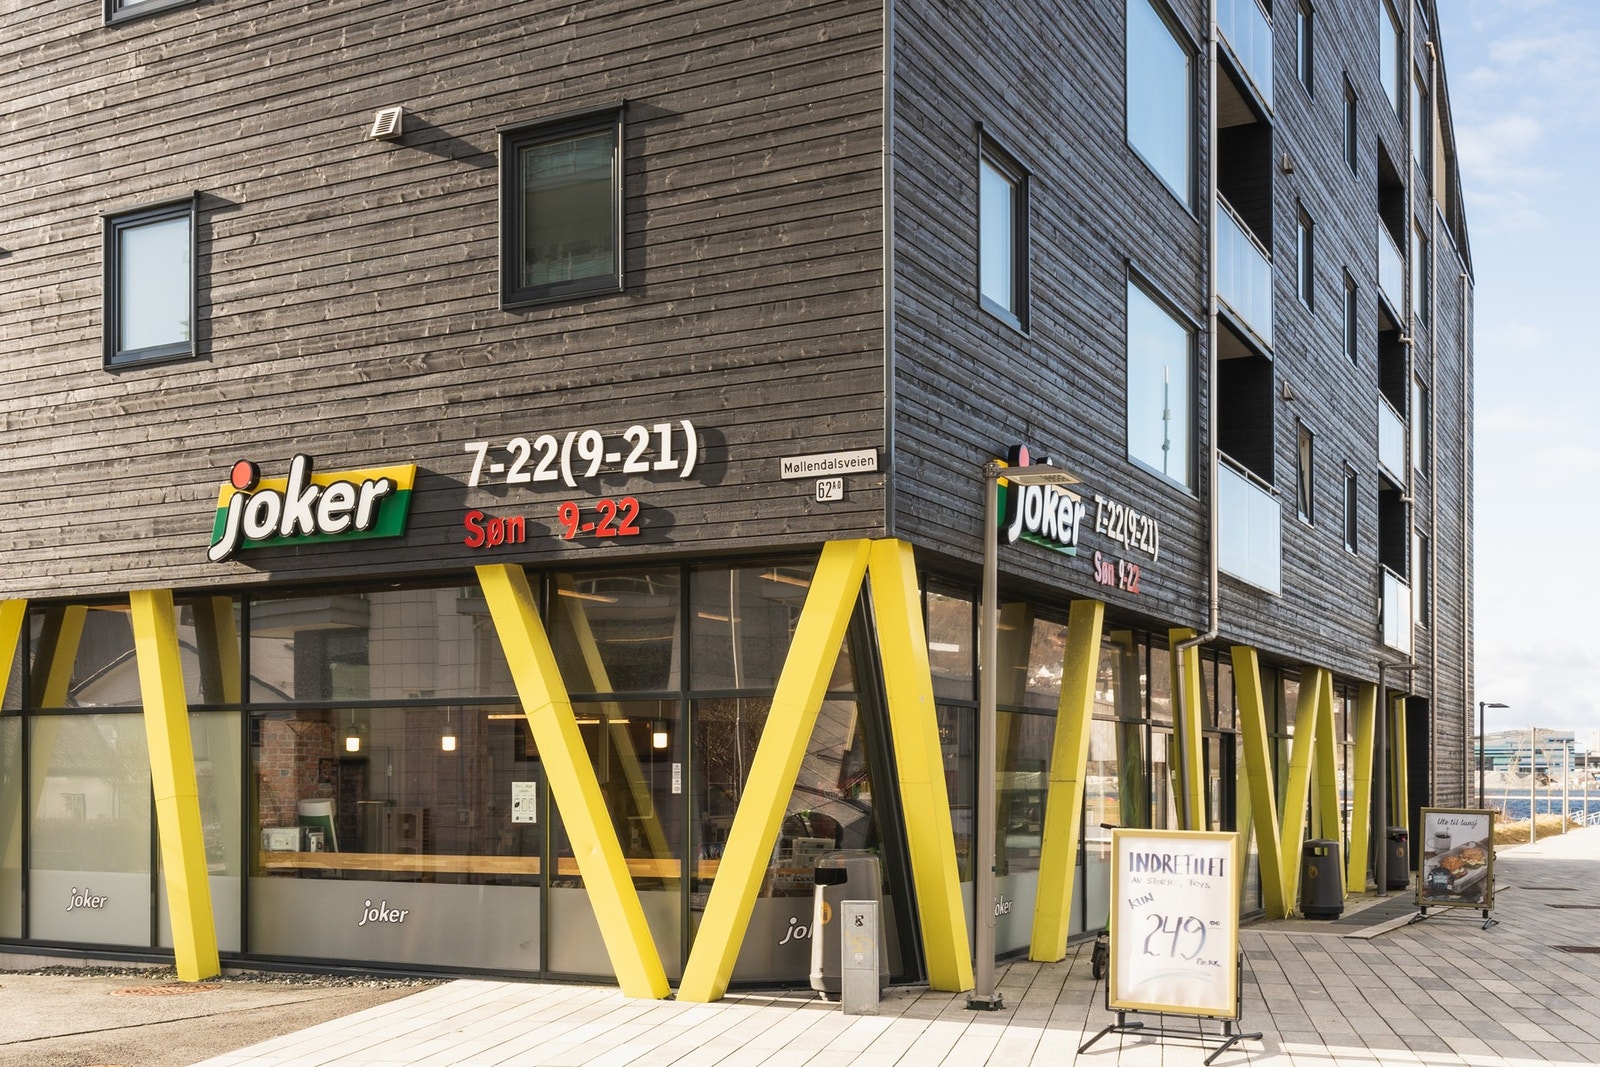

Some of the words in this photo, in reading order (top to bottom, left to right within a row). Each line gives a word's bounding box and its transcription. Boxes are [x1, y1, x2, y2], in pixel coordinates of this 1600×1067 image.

[465, 419, 698, 489] 7-22(9-21)
[784, 455, 875, 474] Møllendalsveien
[207, 453, 398, 563] joker
[1008, 444, 1086, 548] joker
[464, 510, 527, 549] Søn
[557, 496, 641, 541] 9-22
[1094, 550, 1115, 587] Søn
[1118, 558, 1141, 595] 9-22
[66, 886, 108, 912] joker
[357, 898, 409, 926] joker
[1143, 913, 1207, 960] 249
